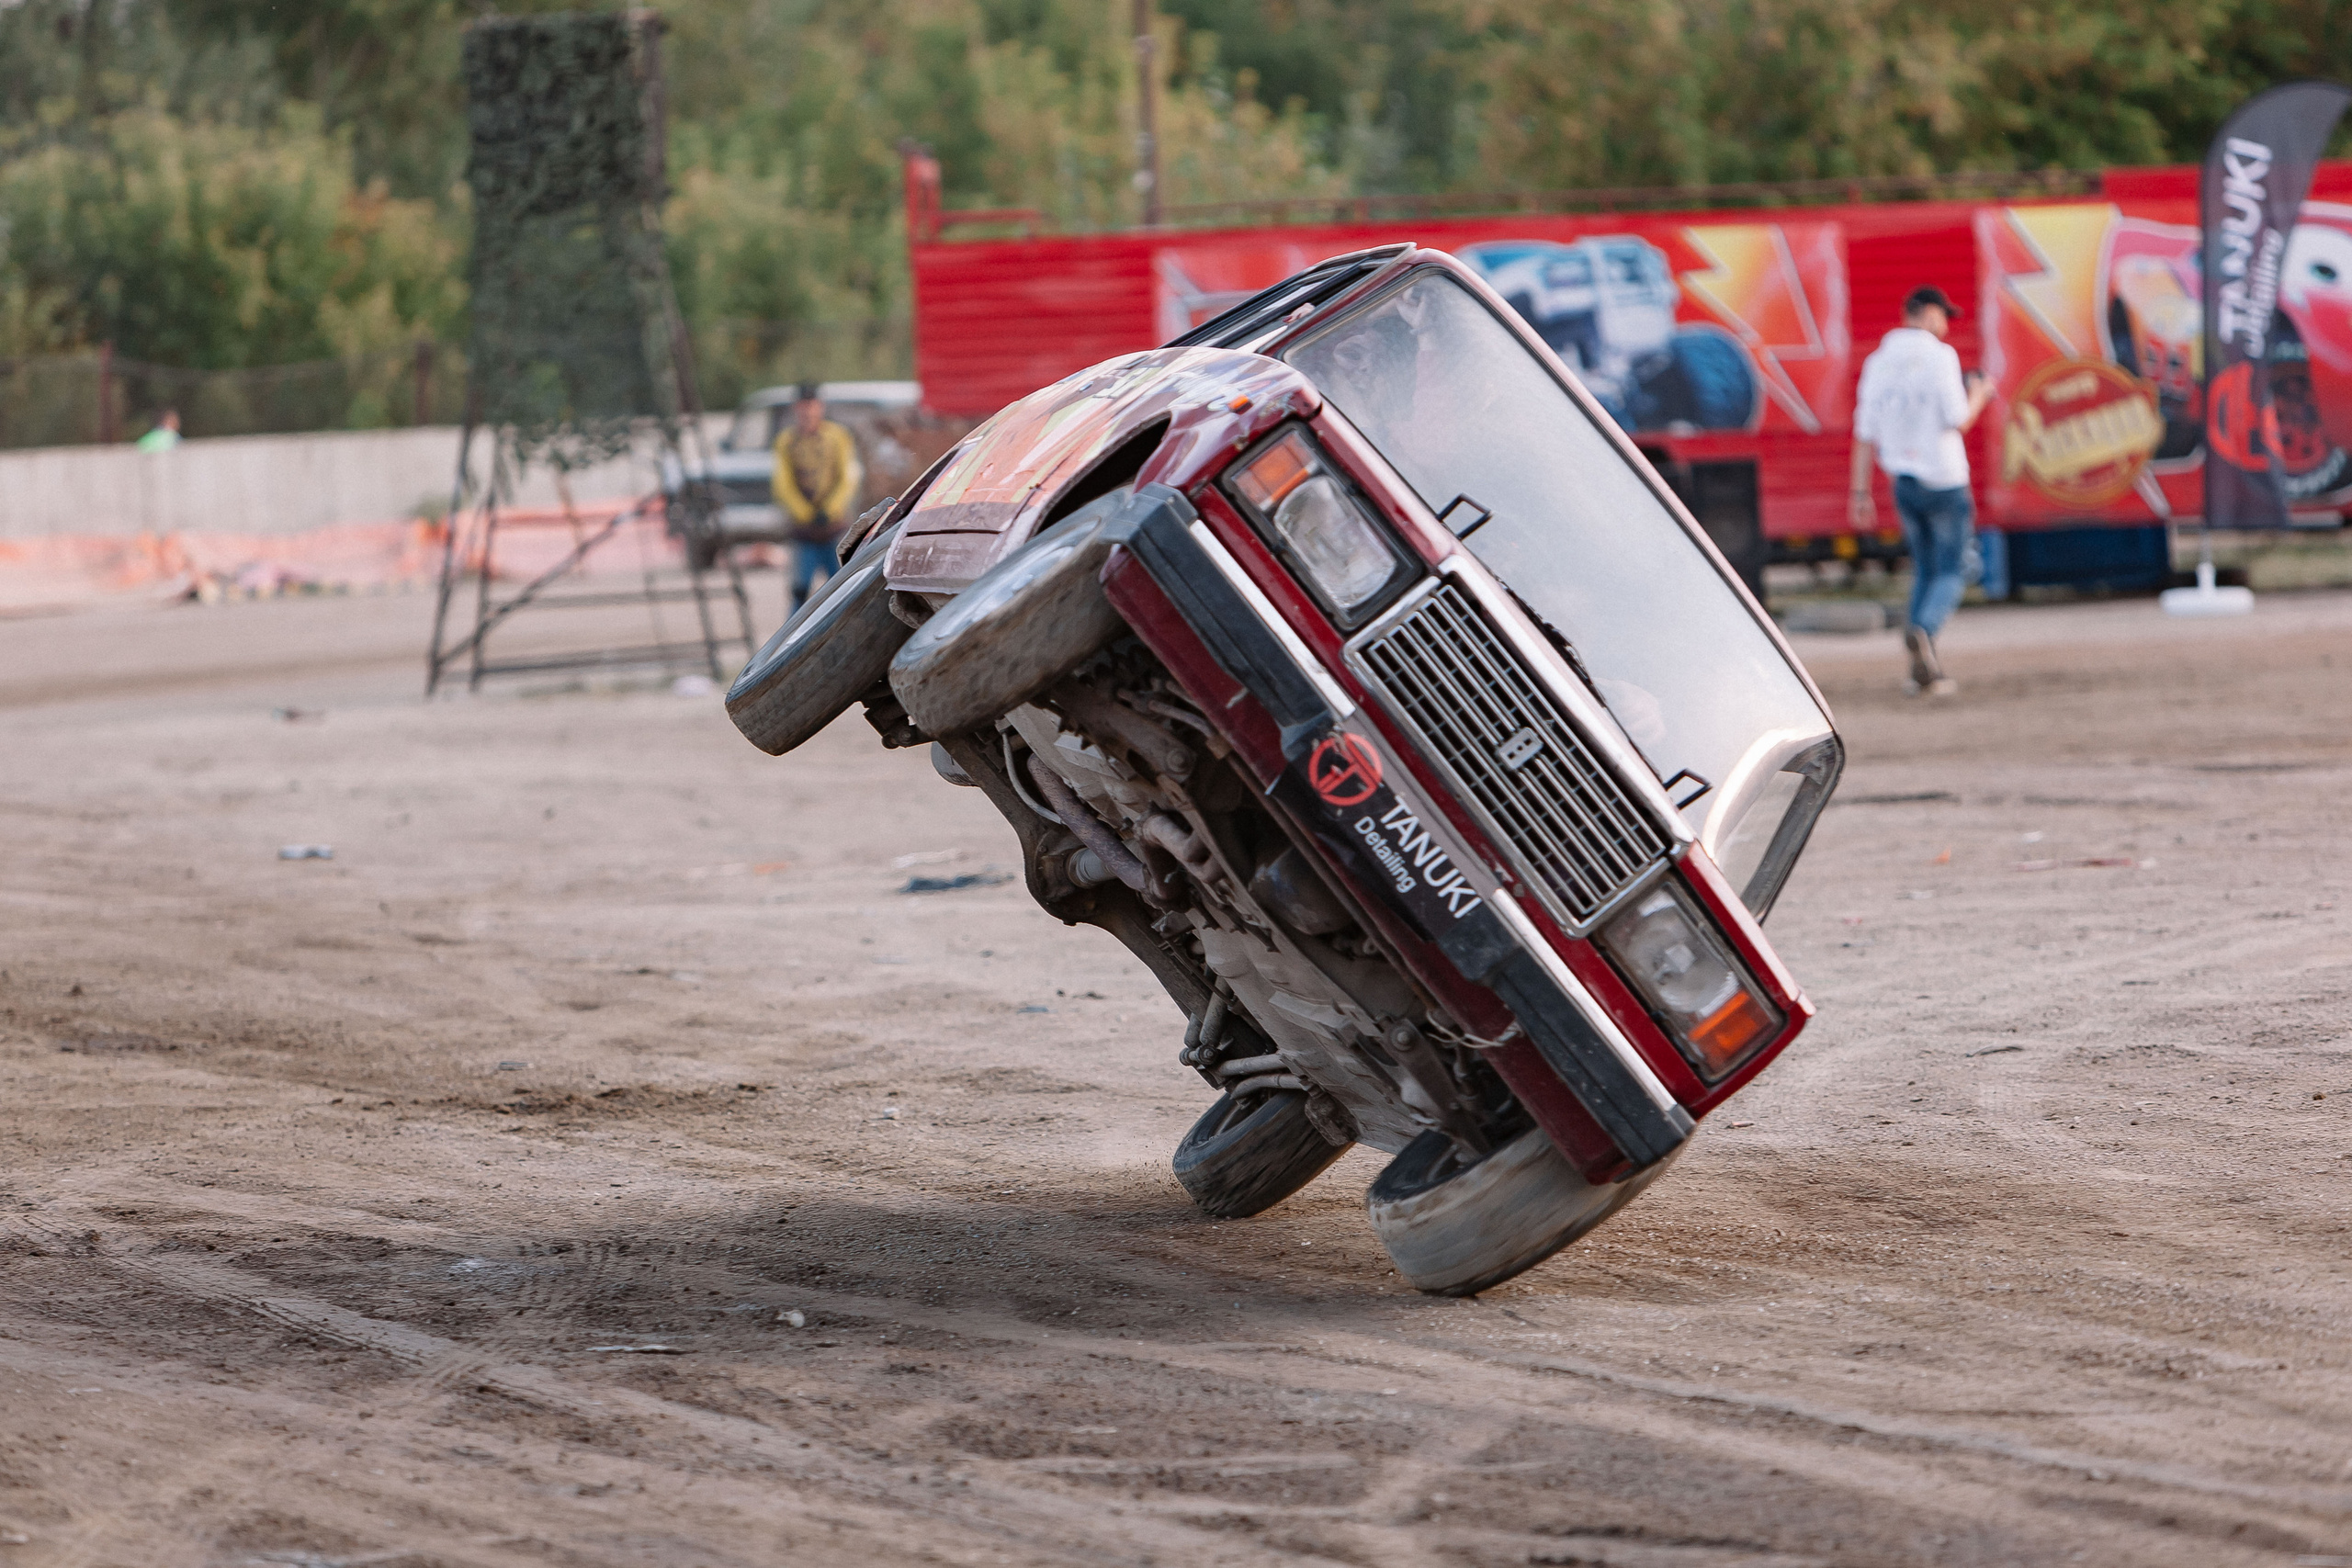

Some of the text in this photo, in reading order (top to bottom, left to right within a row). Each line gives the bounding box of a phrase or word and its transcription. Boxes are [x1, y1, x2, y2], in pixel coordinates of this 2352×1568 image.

[2218, 137, 2273, 344] TANUKI
[1354, 816, 1418, 894] Detailing
[1381, 795, 1483, 919] TANUKI
